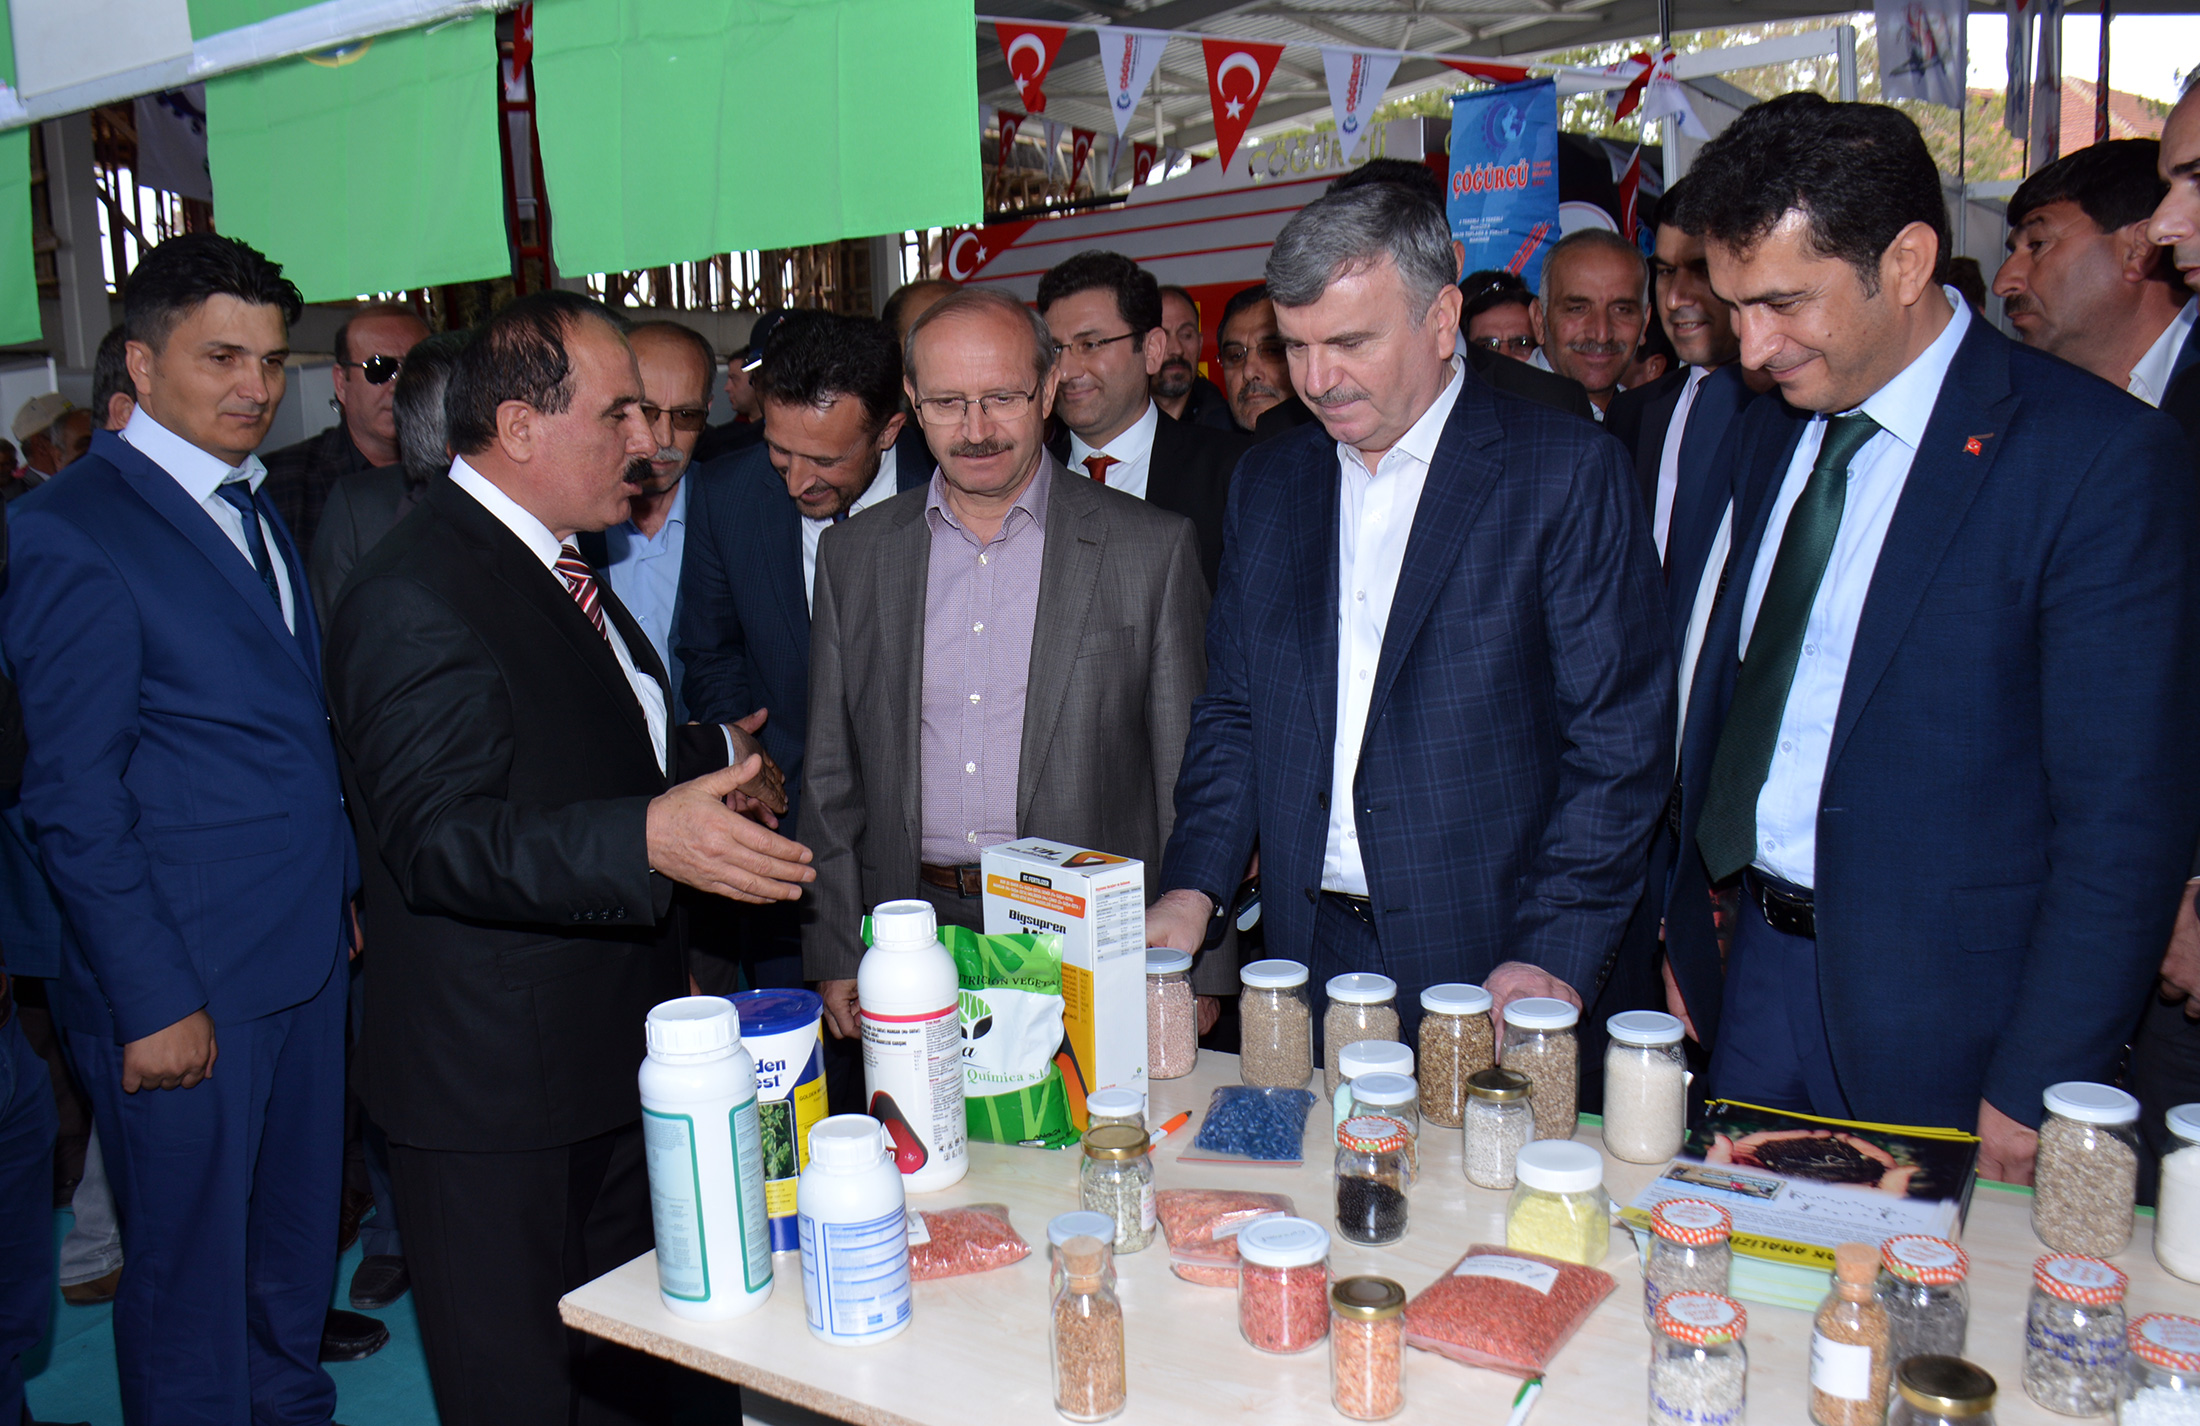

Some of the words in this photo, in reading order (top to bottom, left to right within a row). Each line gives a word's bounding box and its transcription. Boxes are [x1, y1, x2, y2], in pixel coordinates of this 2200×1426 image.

[1452, 158, 1529, 200] ÇÖĞÜRCÜ
[1009, 909, 1066, 935] Bigsupren
[755, 1058, 786, 1073] den
[757, 1074, 780, 1089] est
[967, 1069, 1024, 1085] Química
